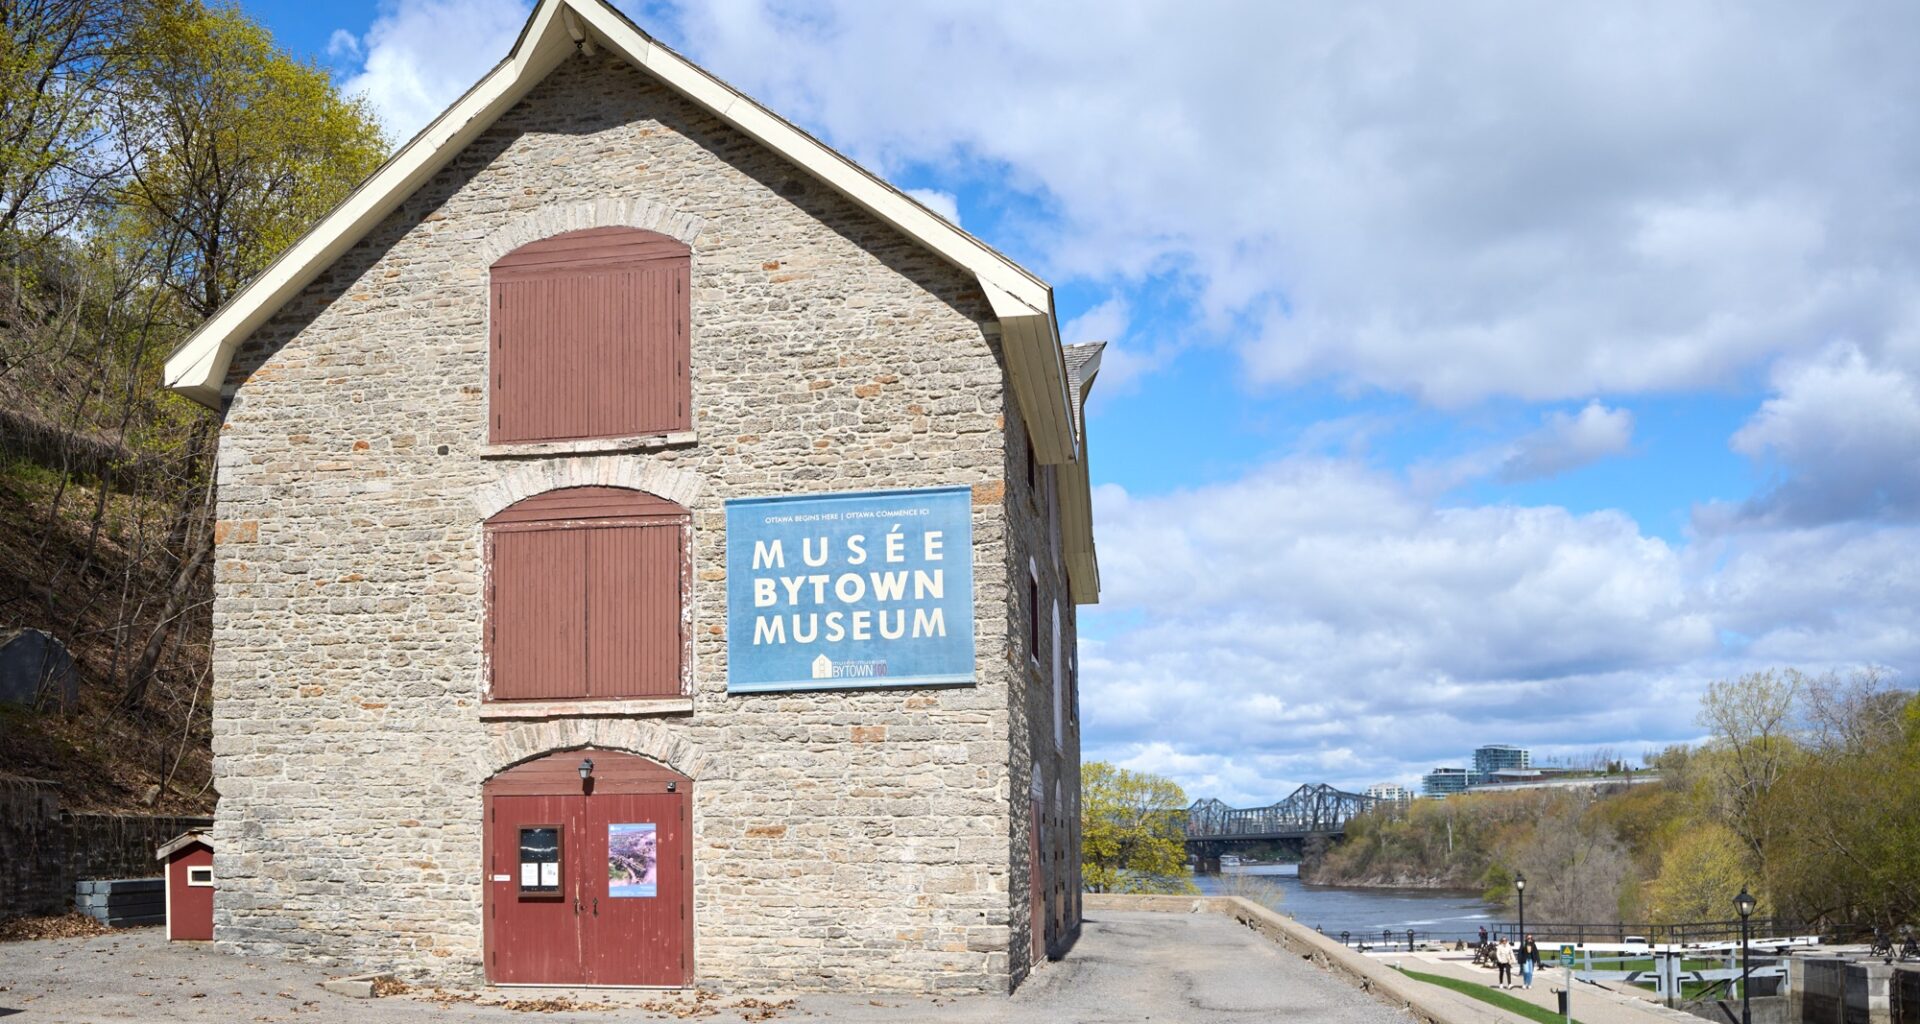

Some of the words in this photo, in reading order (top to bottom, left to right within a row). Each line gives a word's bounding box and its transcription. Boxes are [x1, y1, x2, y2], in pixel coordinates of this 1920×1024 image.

[765, 516, 793, 524] OTTAWA
[795, 514, 820, 522] BEGINS
[846, 511, 875, 519] OTTAWA
[876, 509, 918, 518] COMMENCE
[919, 508, 930, 516] ICI
[752, 524, 943, 570] MUSÉE
[754, 569, 944, 607] BYTOWN
[753, 608, 946, 645] MUSEUM
